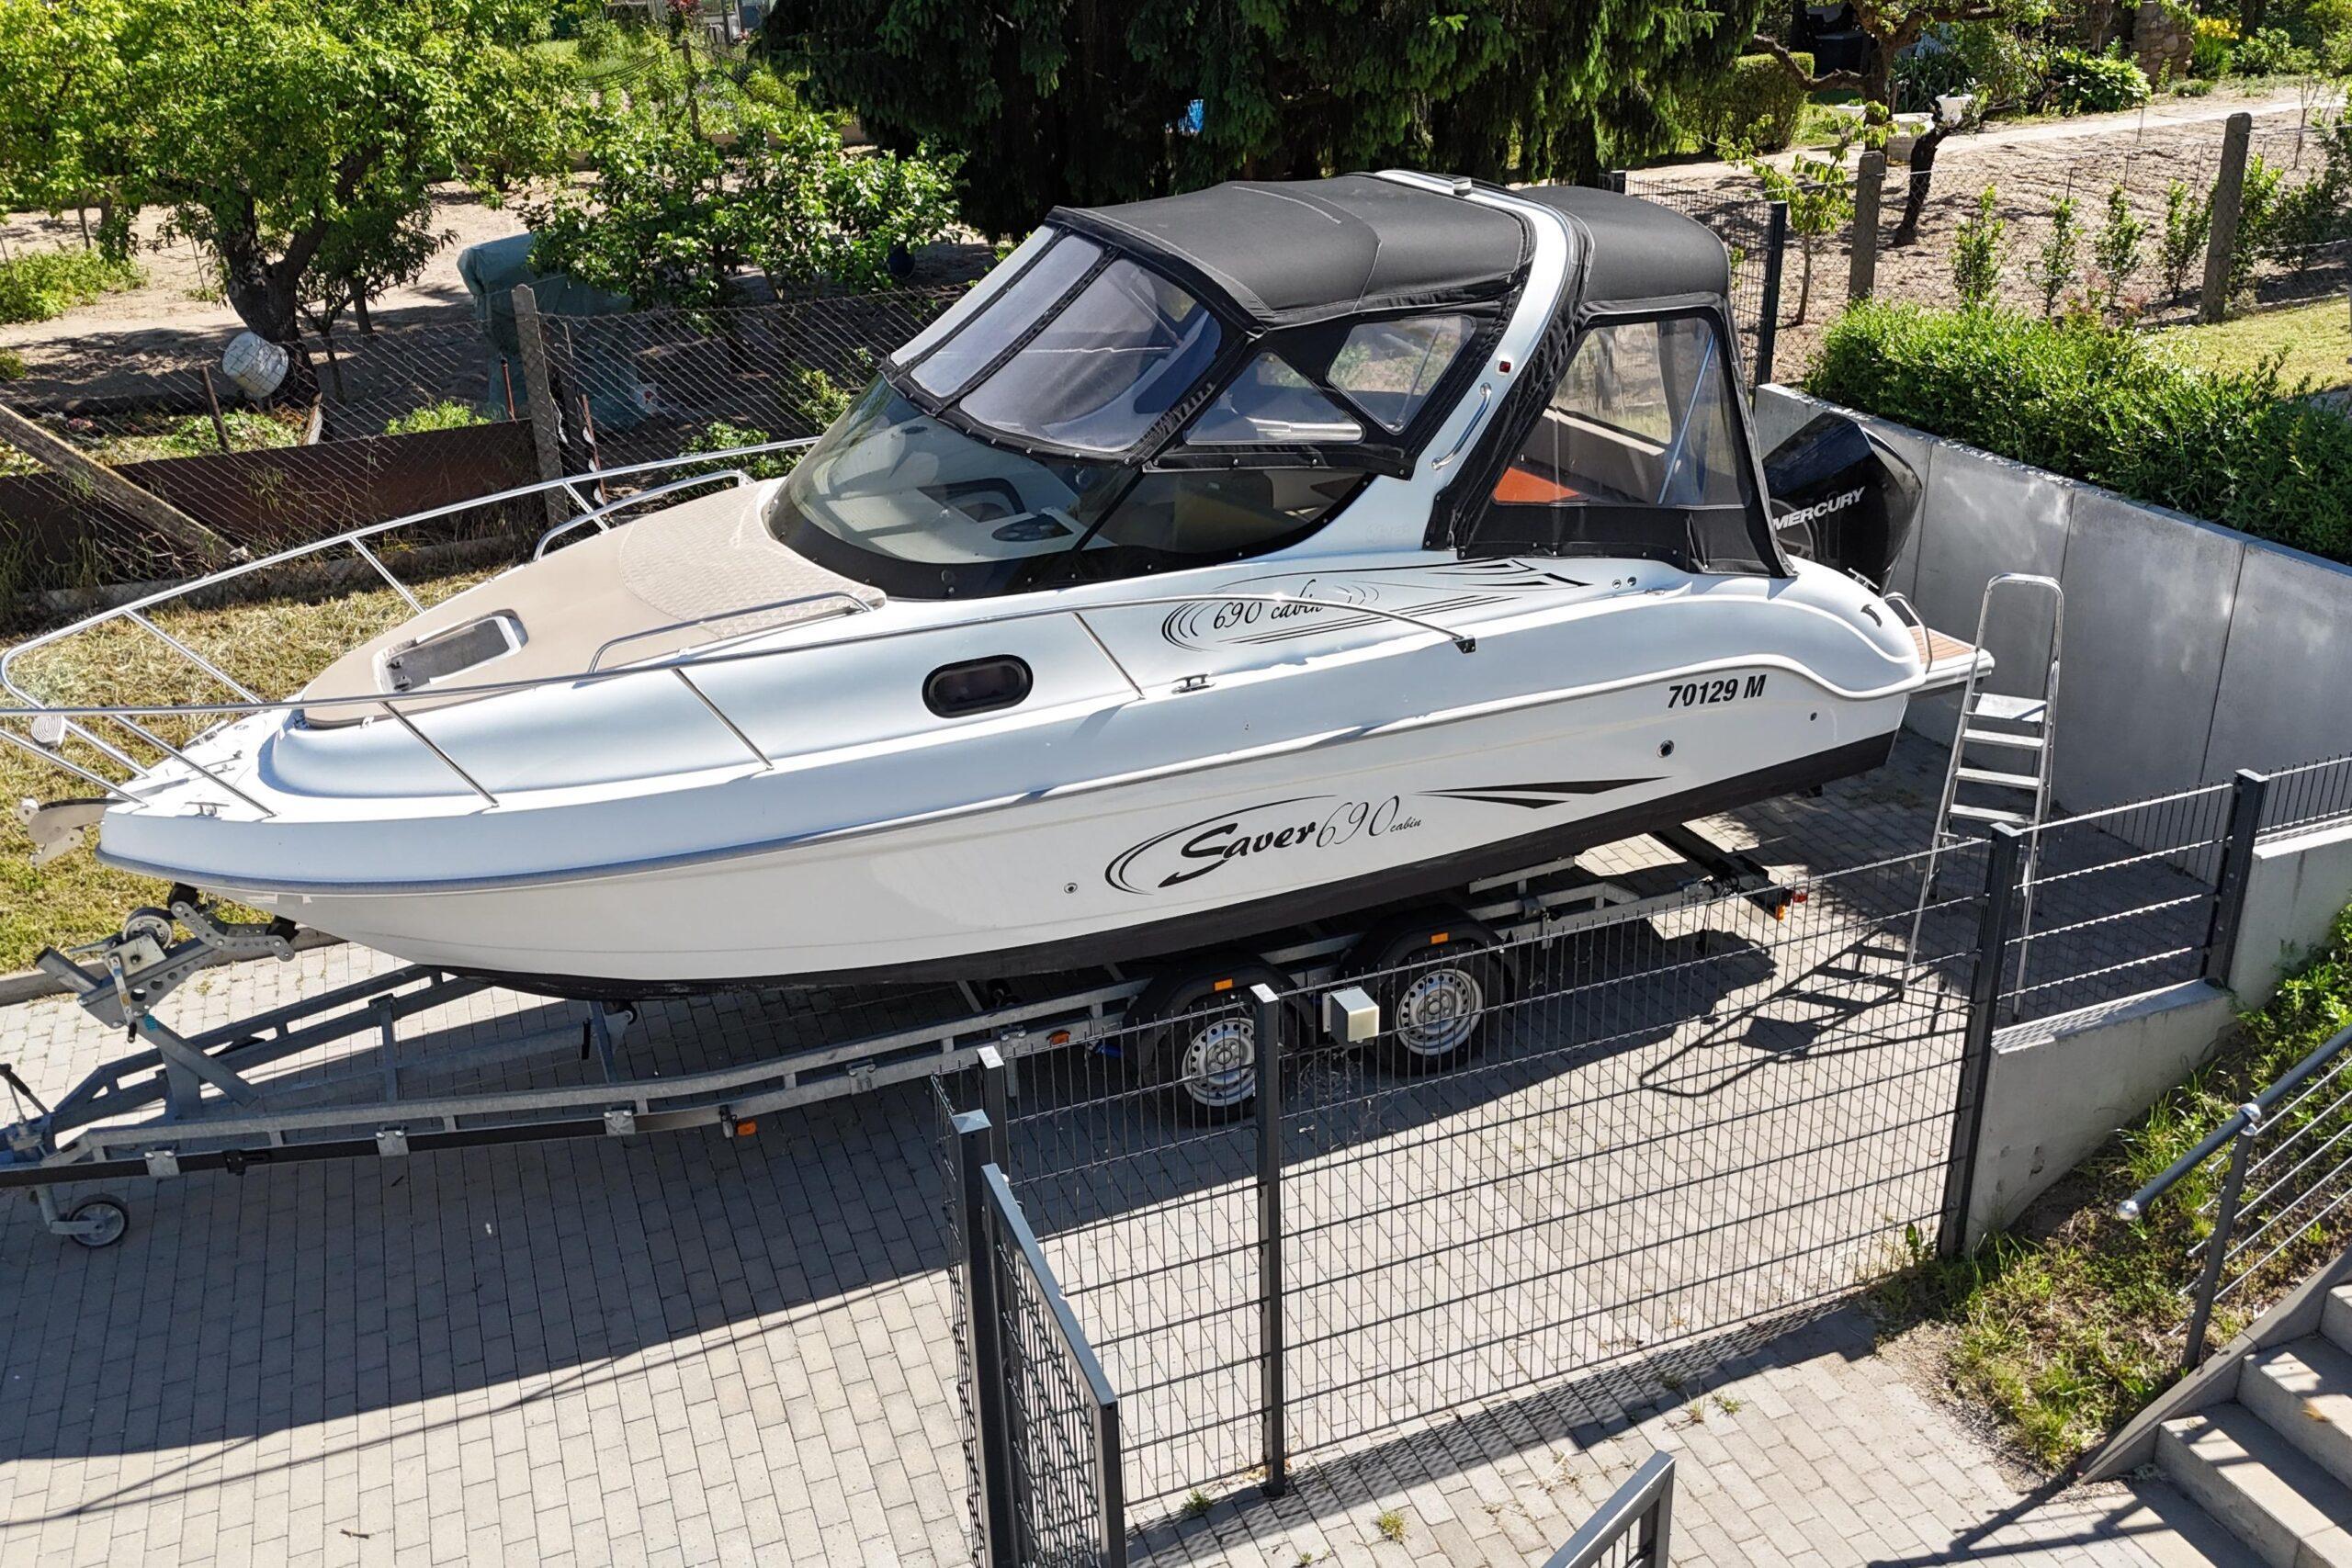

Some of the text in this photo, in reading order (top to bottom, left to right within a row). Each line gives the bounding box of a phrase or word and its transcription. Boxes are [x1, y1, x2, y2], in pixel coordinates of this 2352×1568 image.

[1772, 486, 1866, 530] MERCURY
[1213, 602, 1262, 629] 690
[1668, 673, 1767, 709] 70129 M
[1158, 795, 1422, 888] Saver 690 cabin
